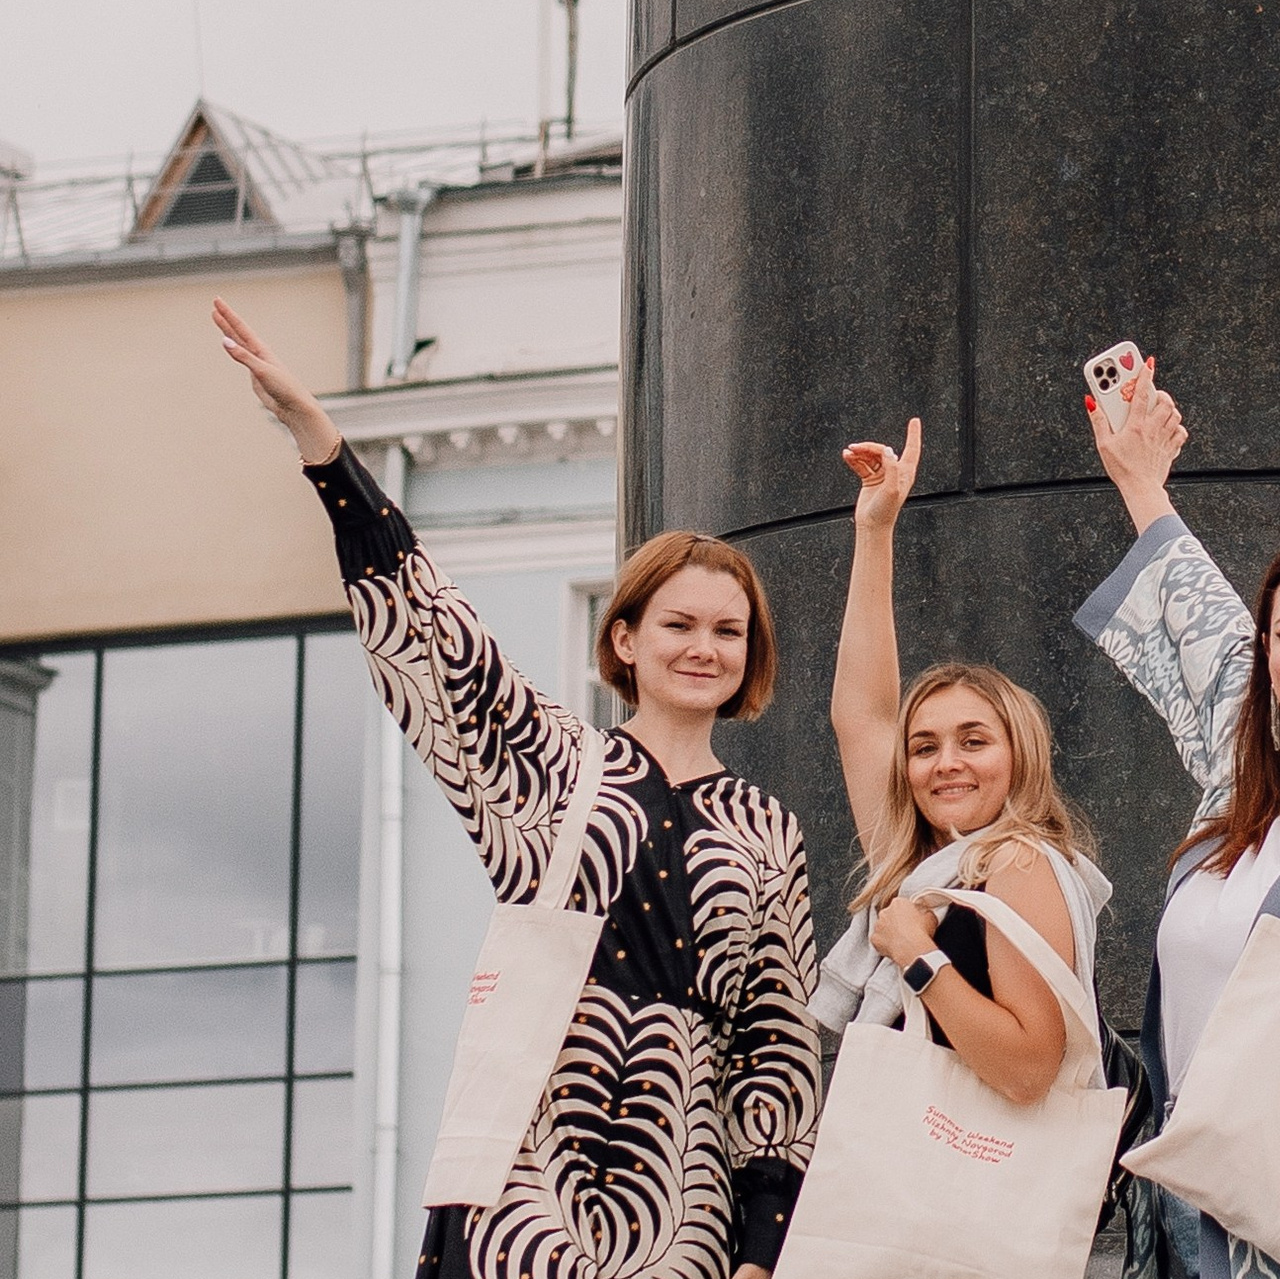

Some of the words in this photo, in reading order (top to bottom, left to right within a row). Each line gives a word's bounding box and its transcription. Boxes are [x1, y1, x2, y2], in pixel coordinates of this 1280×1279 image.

[926, 1105, 964, 1133] Summer
[967, 1131, 1015, 1149] Weekend
[929, 1129, 942, 1140] by
[961, 1139, 1013, 1158] Novgorod
